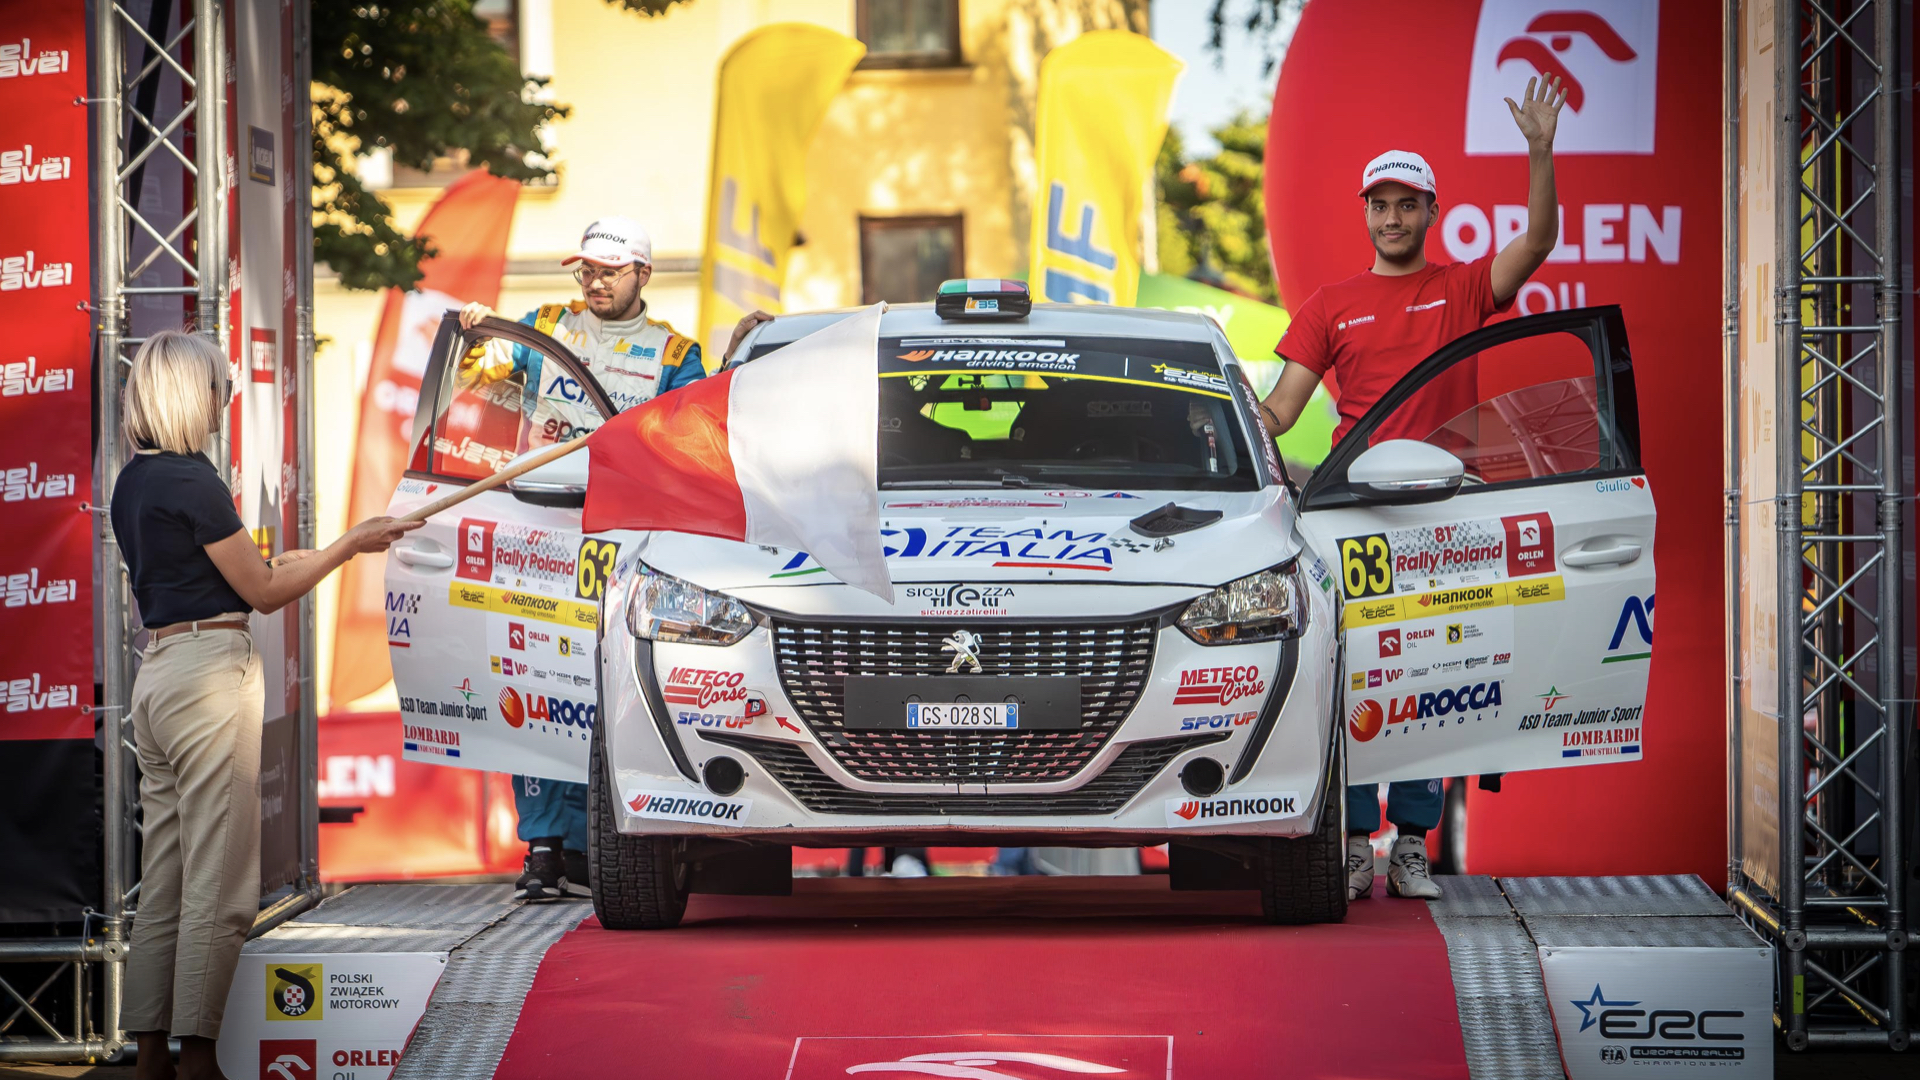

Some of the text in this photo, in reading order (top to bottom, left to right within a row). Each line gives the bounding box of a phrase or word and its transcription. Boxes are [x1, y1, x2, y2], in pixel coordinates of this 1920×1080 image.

[966, 360, 1077, 371] driving emotion
[1596, 480, 1631, 493] Giulio
[947, 526, 1108, 543] TEAM
[465, 555, 485, 566] ORLEN
[494, 547, 576, 576] Rally Poland
[927, 541, 1114, 565] ITALIA
[1395, 540, 1504, 574] Rally Poland
[1518, 550, 1544, 561] ORLEN
[578, 539, 617, 600] 63
[1342, 536, 1391, 597] 63
[1448, 600, 1495, 612] driving emotion
[528, 631, 550, 643] ORLEN
[1406, 629, 1435, 641] ORLEN
[528, 641, 537, 649] OIL
[667, 667, 744, 688] METECO
[1180, 665, 1259, 687] METECO
[1385, 668, 1403, 683] WP
[698, 686, 748, 709] Corse
[1219, 679, 1265, 706] Corse
[400, 697, 488, 722] ASD Team Junior Sport
[1387, 681, 1502, 725] LAROCCA
[677, 711, 754, 729] SPOTUP
[950, 706, 979, 725] 028
[983, 706, 1003, 725] SL
[1180, 710, 1258, 731] SPOTUP
[1518, 704, 1642, 731] ASD Team Junior Sport
[404, 724, 460, 746] LOMBARDI
[1563, 727, 1640, 747] LOMBARDI
[417, 744, 446, 756] INDUSTRIAL
[1582, 746, 1621, 757] INDUSTRIAL
[330, 974, 373, 983] POLSKI
[330, 987, 384, 998] ZWIĄZEK
[282, 1006, 307, 1016] PZM
[330, 999, 400, 1009] MOTOROWY
[1599, 1010, 1745, 1041] ERC
[332, 1050, 402, 1067] ORLEN
[1601, 1049, 1624, 1061] FIA
[1632, 1048, 1742, 1058] EUROPEAN RALLY
